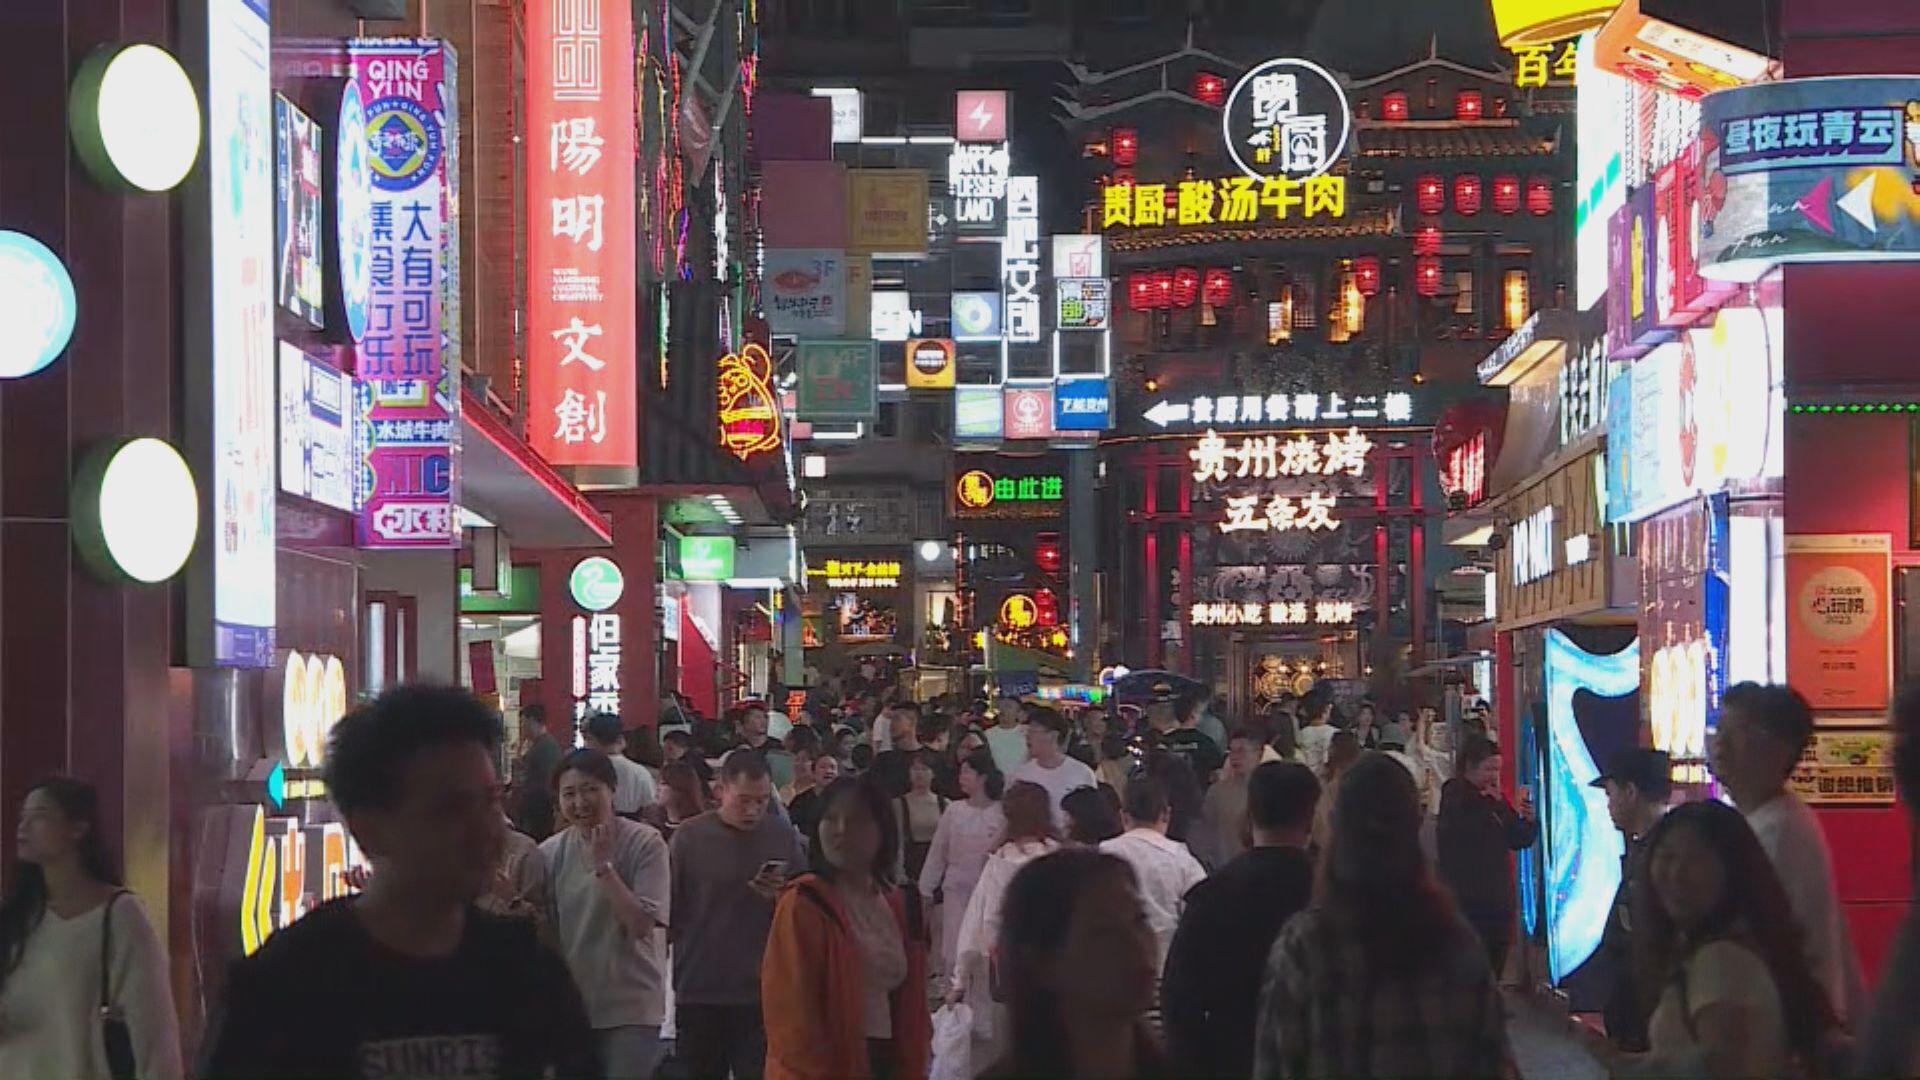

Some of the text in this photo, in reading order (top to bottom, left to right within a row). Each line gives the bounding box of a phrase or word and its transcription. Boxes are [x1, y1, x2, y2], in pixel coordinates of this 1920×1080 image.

[367, 81, 422, 101] YUN
[368, 60, 429, 80] QING
[1725, 110, 1894, 156] 昼夜玩青云
[401, 200, 433, 375] 大有可玩
[551, 116, 606, 444] 陽明 文創
[1189, 427, 1372, 482] 贵州烧烤
[995, 476, 1063, 500] 由此进
